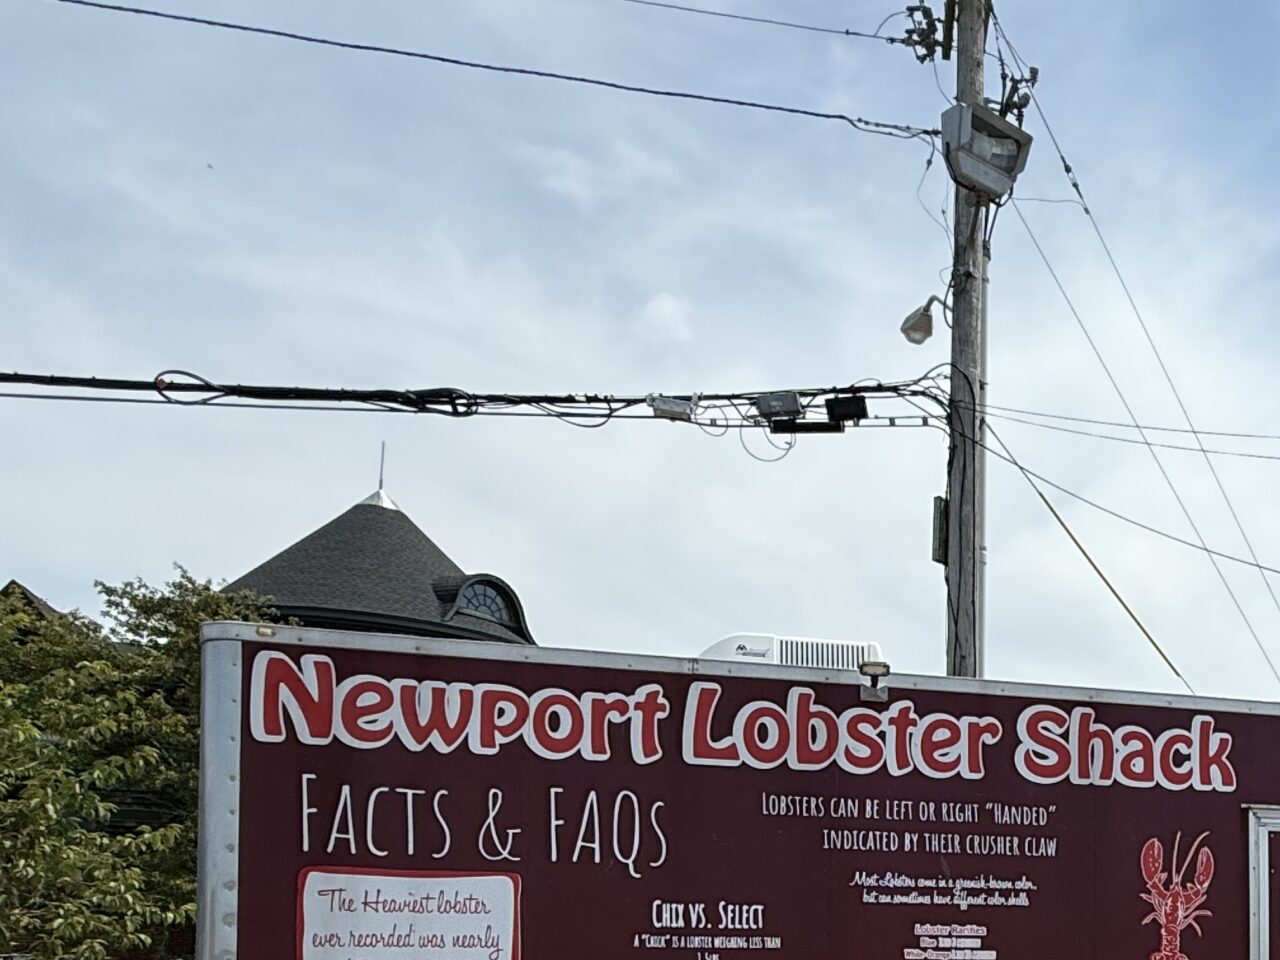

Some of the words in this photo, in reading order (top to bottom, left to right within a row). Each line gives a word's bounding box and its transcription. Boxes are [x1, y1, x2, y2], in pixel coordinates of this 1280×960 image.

[250, 651, 669, 764] Newport
[683, 681, 1002, 780] Lobster
[1015, 705, 1237, 792] Shack
[762, 792, 825, 817] LOBSTERS
[830, 798, 859, 818] CAN
[865, 799, 880, 819] BE
[886, 800, 913, 820] LEFT
[919, 801, 936, 821] OR
[942, 802, 979, 823] RIGHT
[479, 789, 521, 861] &
[823, 829, 899, 851] INDICATED
[904, 832, 918, 852] BY
[924, 833, 961, 854] THEIR
[966, 834, 1020, 856] CRUSHER
[1025, 837, 1057, 857] CLAW
[318, 889, 356, 914] The
[362, 890, 434, 914] Heaviest
[437, 890, 491, 914] lobster
[652, 900, 685, 928] CHIX
[689, 903, 712, 928] VS.
[718, 901, 764, 929] SELECT
[312, 934, 345, 947] ever
[350, 924, 415, 948] recorded
[418, 934, 445, 948] was
[453, 925, 503, 960] nearly
